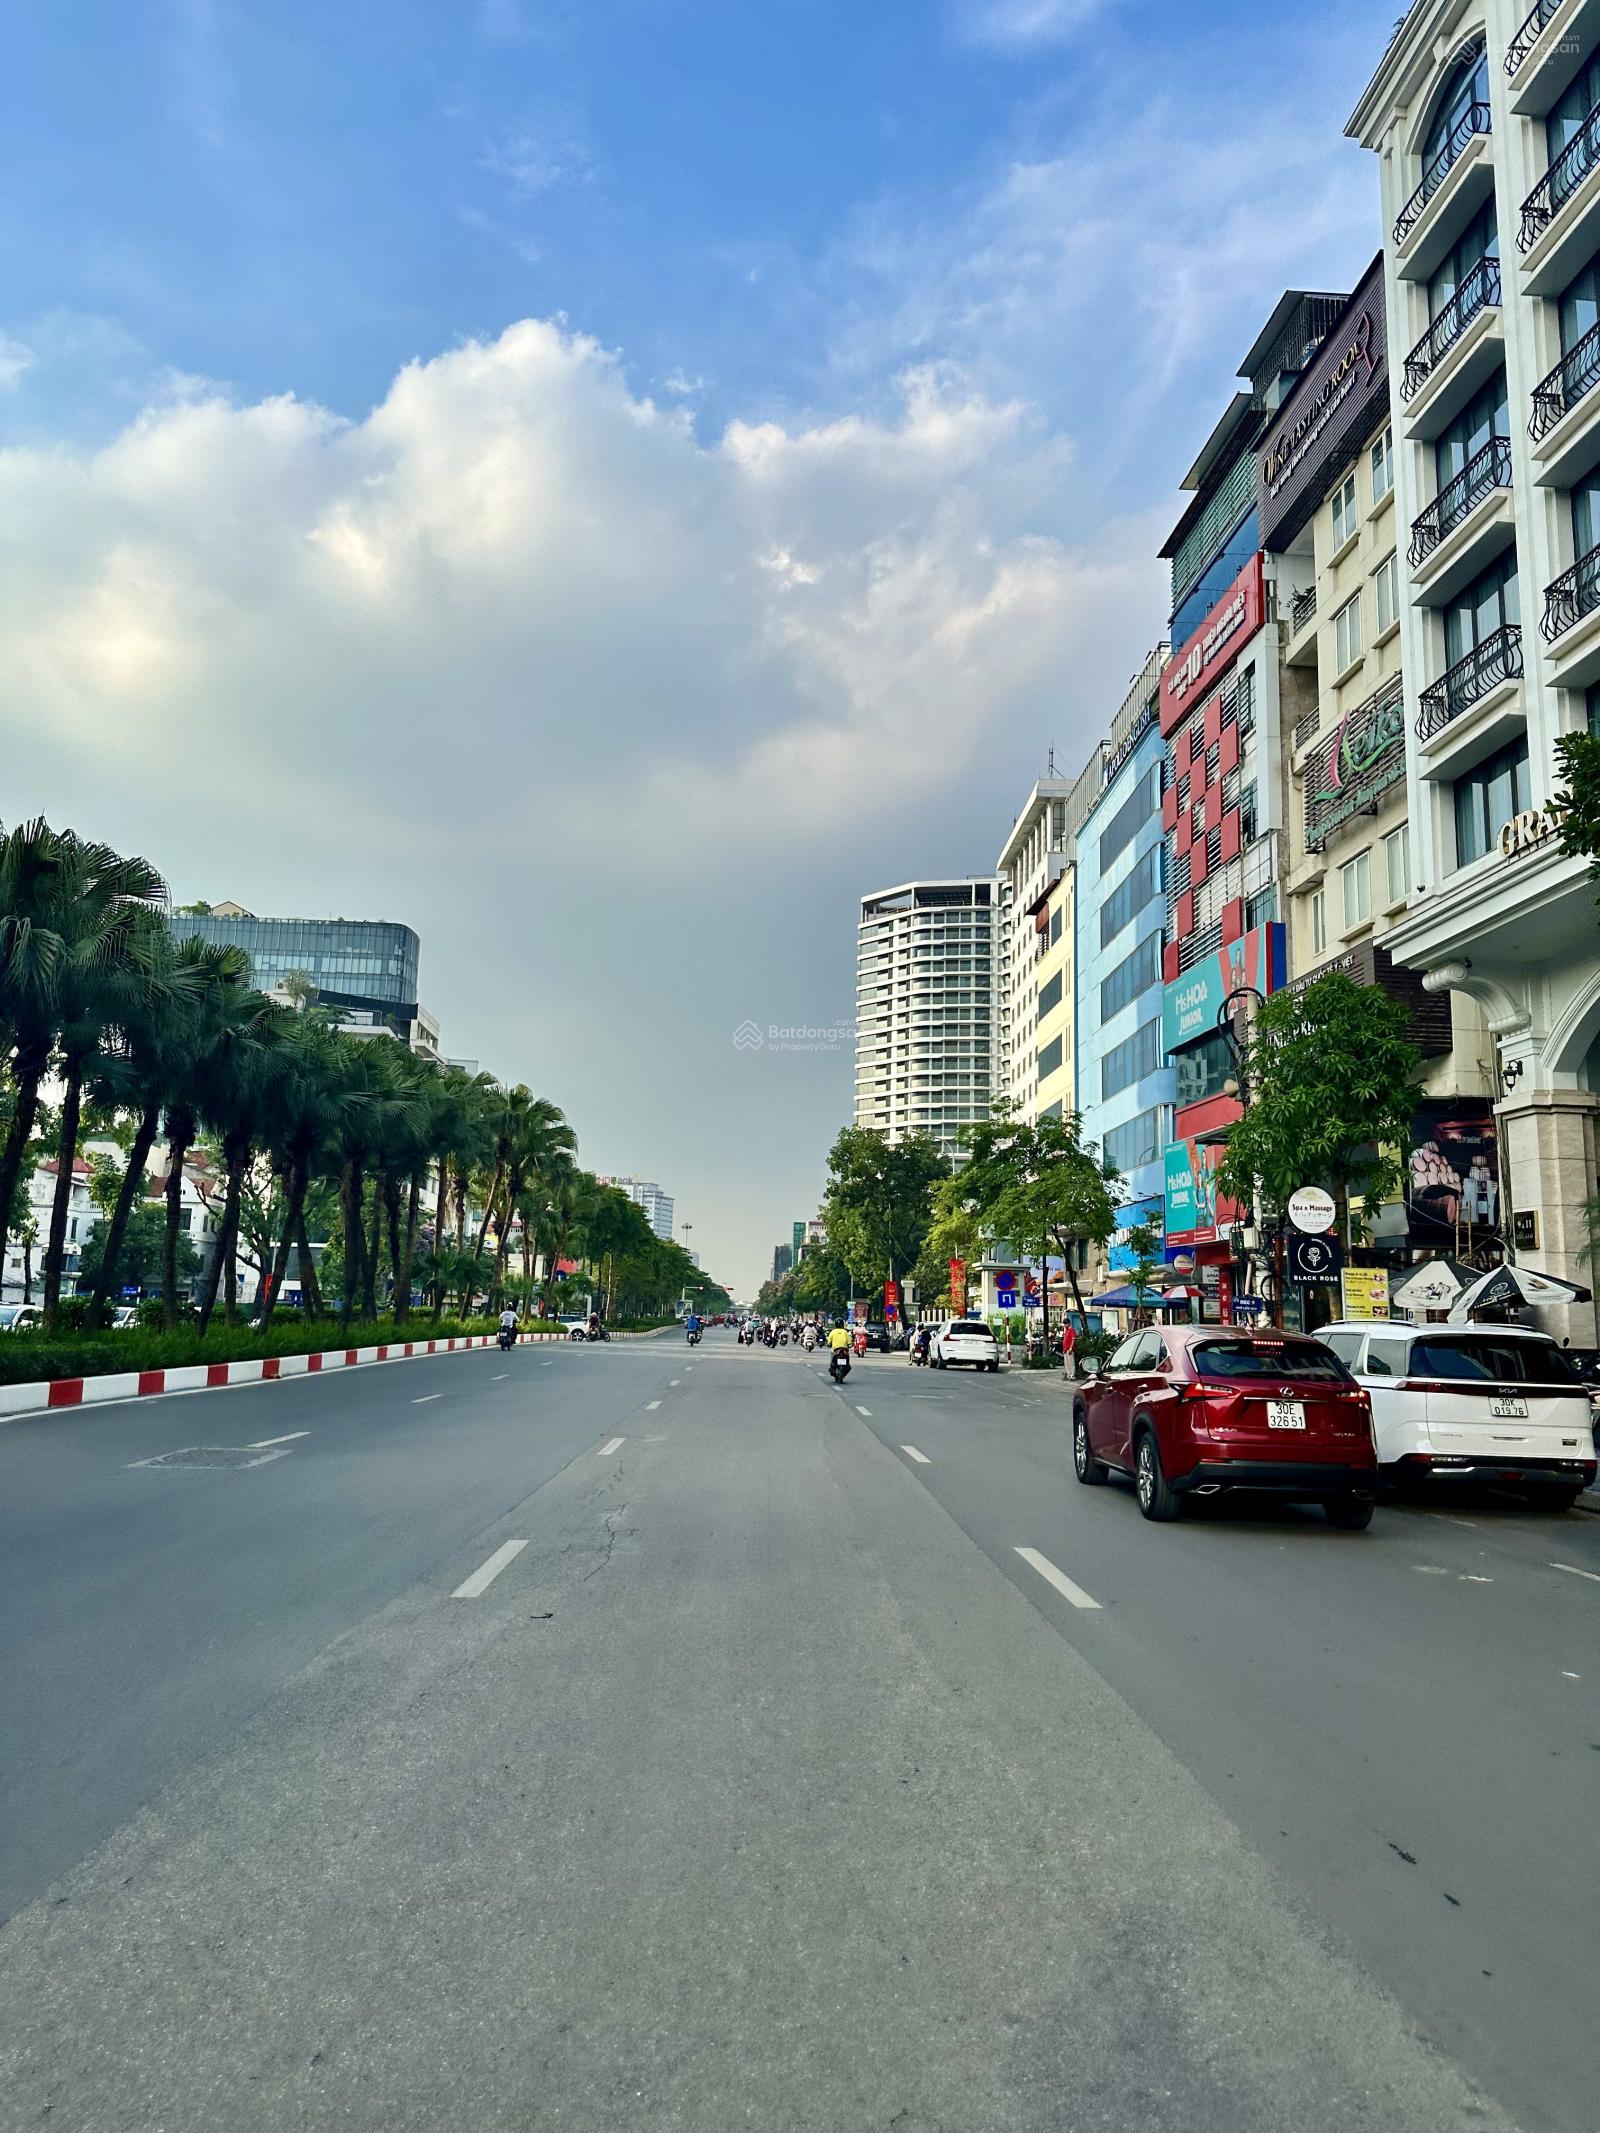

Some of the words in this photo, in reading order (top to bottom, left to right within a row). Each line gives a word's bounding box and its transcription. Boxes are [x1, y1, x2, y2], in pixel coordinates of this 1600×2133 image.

[1187, 643, 1204, 687] 10
[1292, 1203, 1303, 1211] Spa
[1309, 1204, 1333, 1212] Massage
[1500, 1398, 1516, 1407] 30K
[1276, 1403, 1295, 1415] 30E
